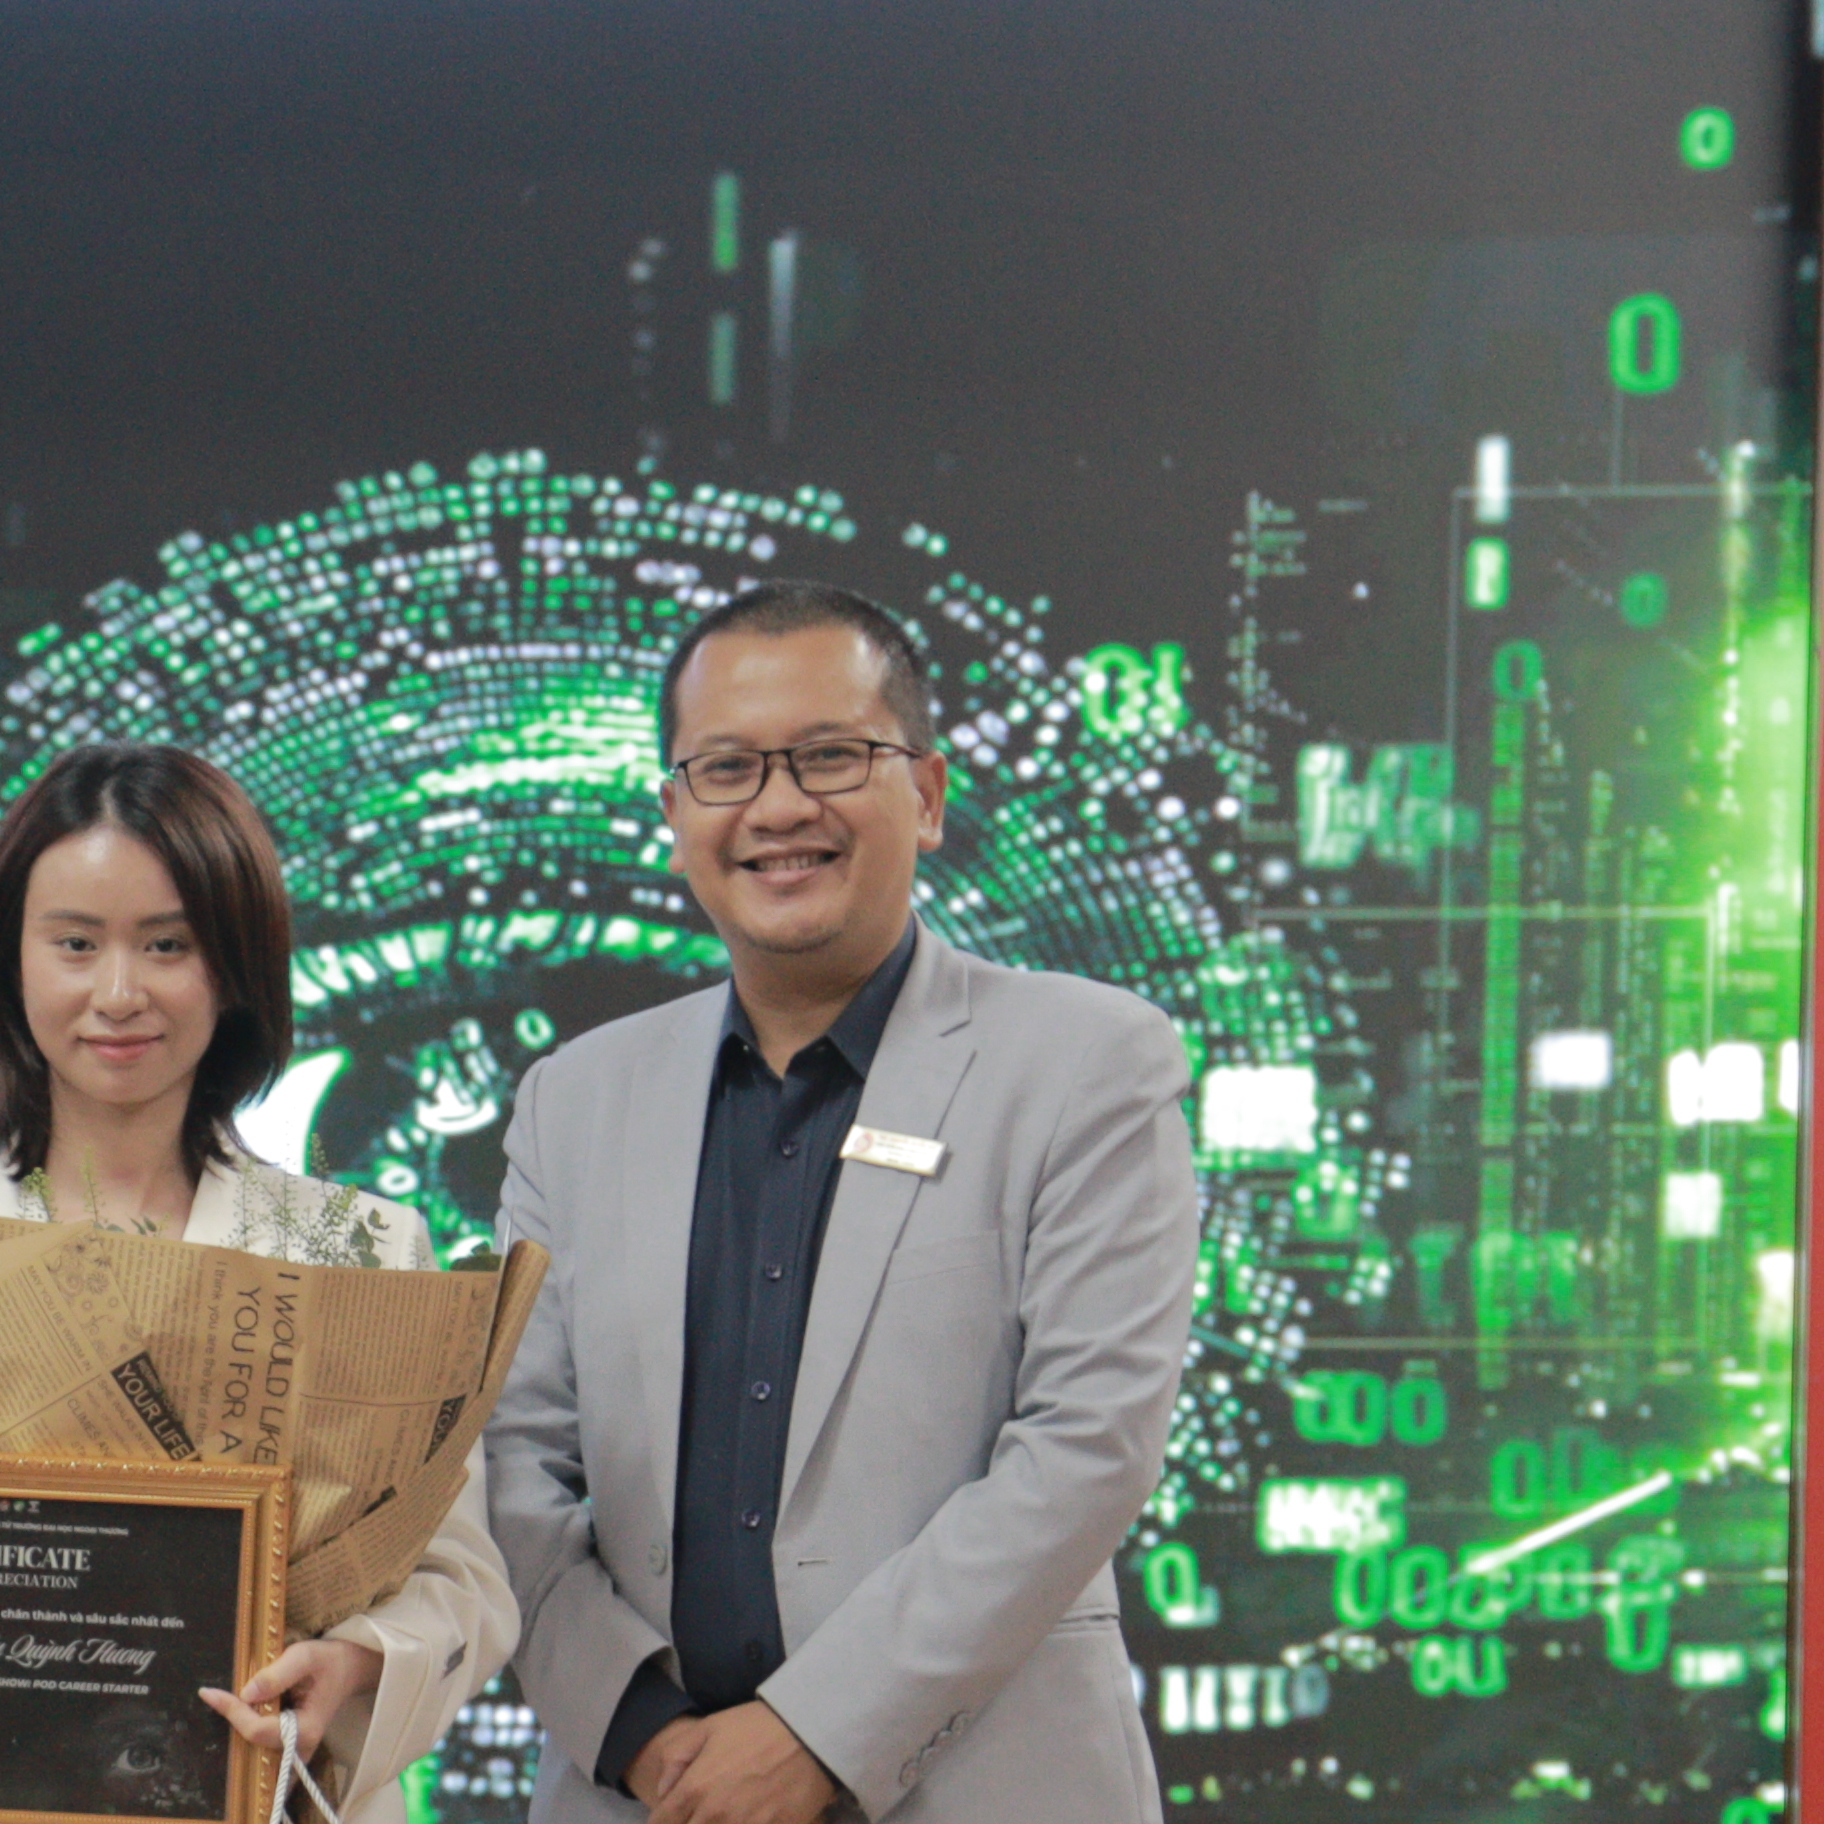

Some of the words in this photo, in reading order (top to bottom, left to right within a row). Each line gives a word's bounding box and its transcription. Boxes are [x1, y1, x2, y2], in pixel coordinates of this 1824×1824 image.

[230, 1287, 261, 1352] YOU
[265, 1293, 298, 1397] WOULD
[113, 1362, 162, 1423] YOUR
[150, 1416, 191, 1463] LIFE
[220, 1362, 252, 1419] FOR
[219, 1430, 243, 1454] A
[253, 1406, 285, 1465] LIKE
